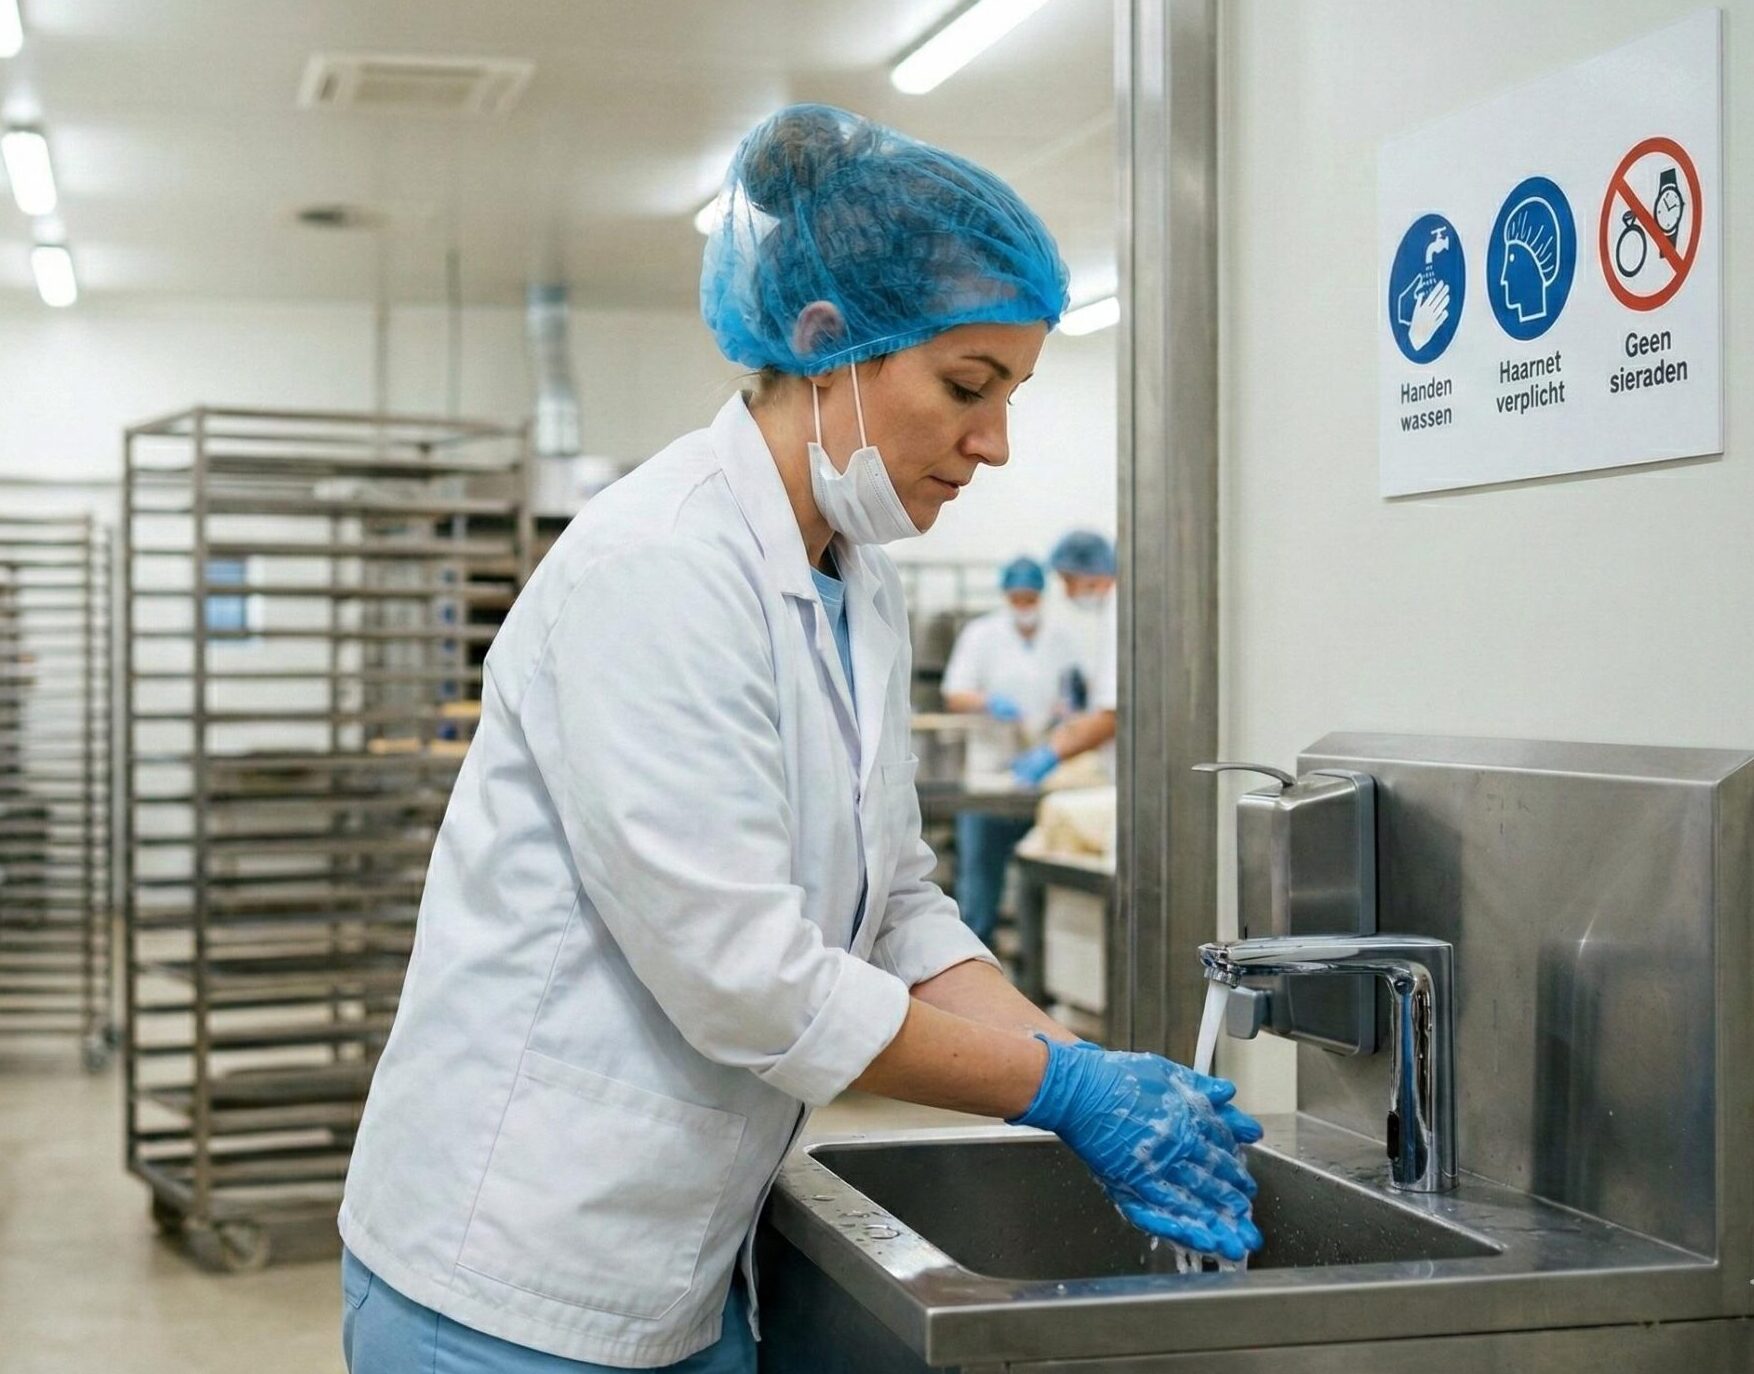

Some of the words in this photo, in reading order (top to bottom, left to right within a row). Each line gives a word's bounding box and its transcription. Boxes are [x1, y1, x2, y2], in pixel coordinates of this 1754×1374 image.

[1625, 330, 1672, 358] Geen
[1499, 350, 1562, 384] Haarnet
[1609, 359, 1689, 394] sieraden
[1400, 376, 1452, 405] Handen
[1496, 381, 1566, 415] verplicht
[1400, 407, 1452, 432] wassen
